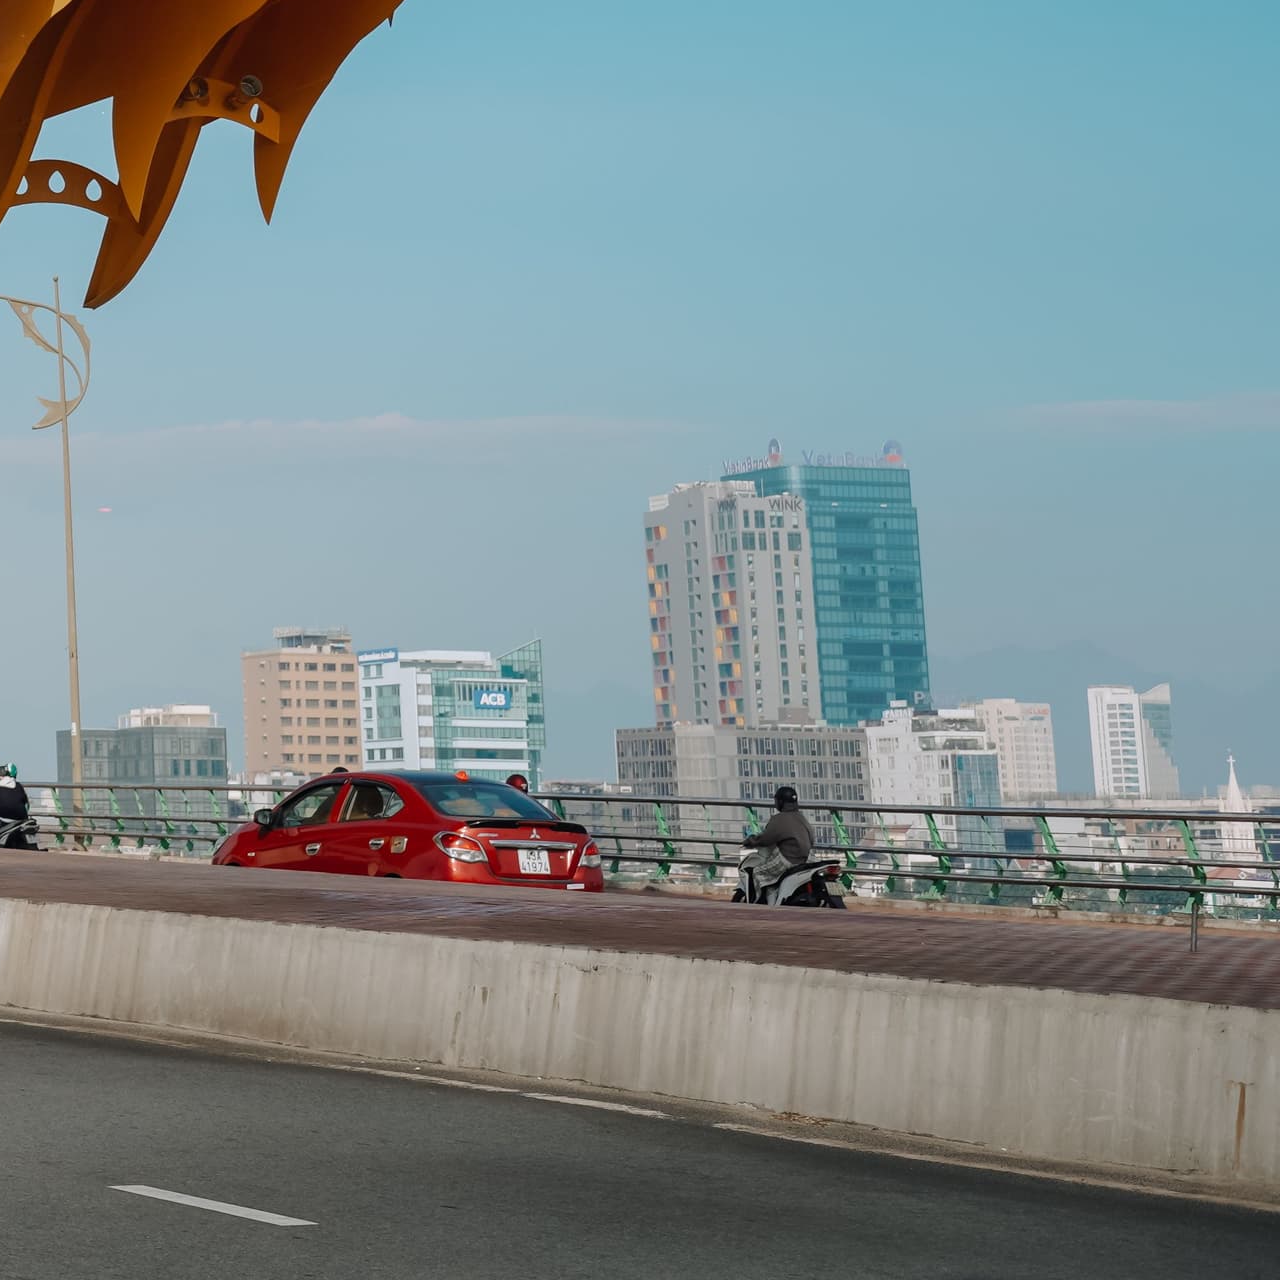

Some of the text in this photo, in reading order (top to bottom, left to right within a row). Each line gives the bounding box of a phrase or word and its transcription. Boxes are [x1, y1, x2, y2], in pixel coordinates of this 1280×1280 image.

[768, 498, 802, 512] WINK
[480, 693, 506, 706] ACB
[522, 862, 549, 872] 41974
